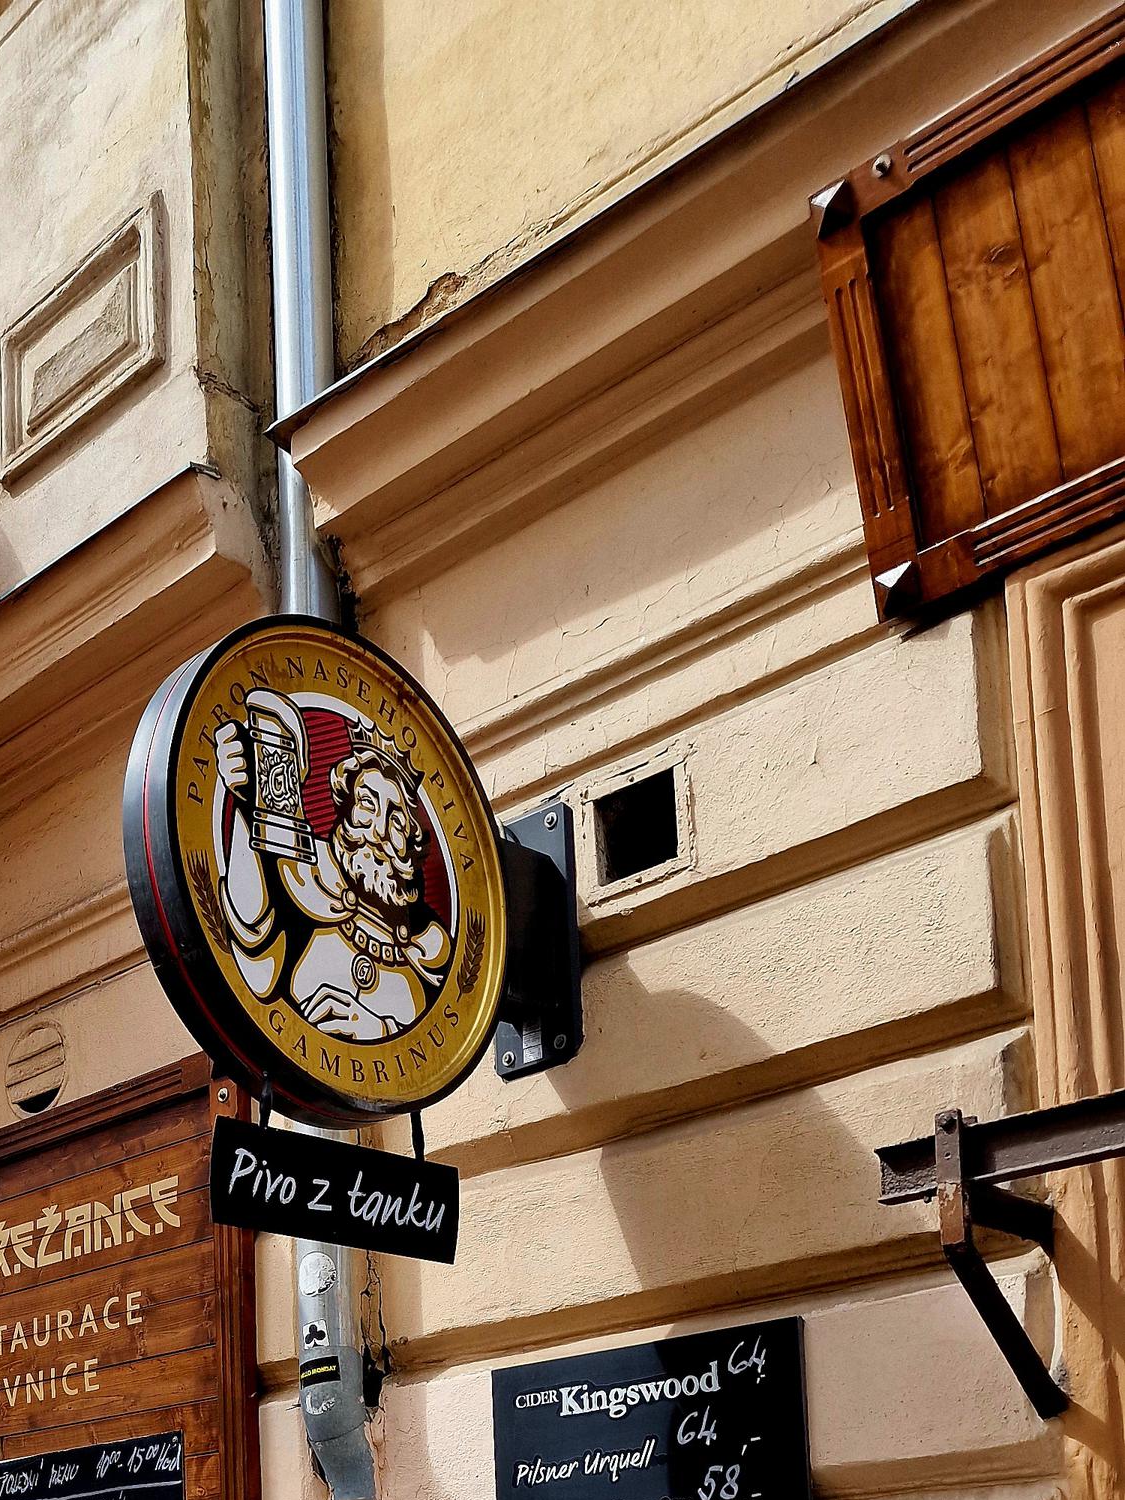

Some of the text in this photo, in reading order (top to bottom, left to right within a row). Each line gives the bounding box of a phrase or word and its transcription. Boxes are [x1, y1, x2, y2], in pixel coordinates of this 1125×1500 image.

[187, 656, 475, 874] PATRON NAŠEHO PIVA
[267, 1004, 460, 1085] GAMBRINUS
[228, 1147, 446, 1234] Pivo z tanku
[515, 1389, 560, 1409] CIDER
[560, 1360, 722, 1419] Kingswood
[48, 1464, 79, 1489] MENU
[516, 1458, 579, 1487] Pilsner
[584, 1438, 656, 1483] Urquell
